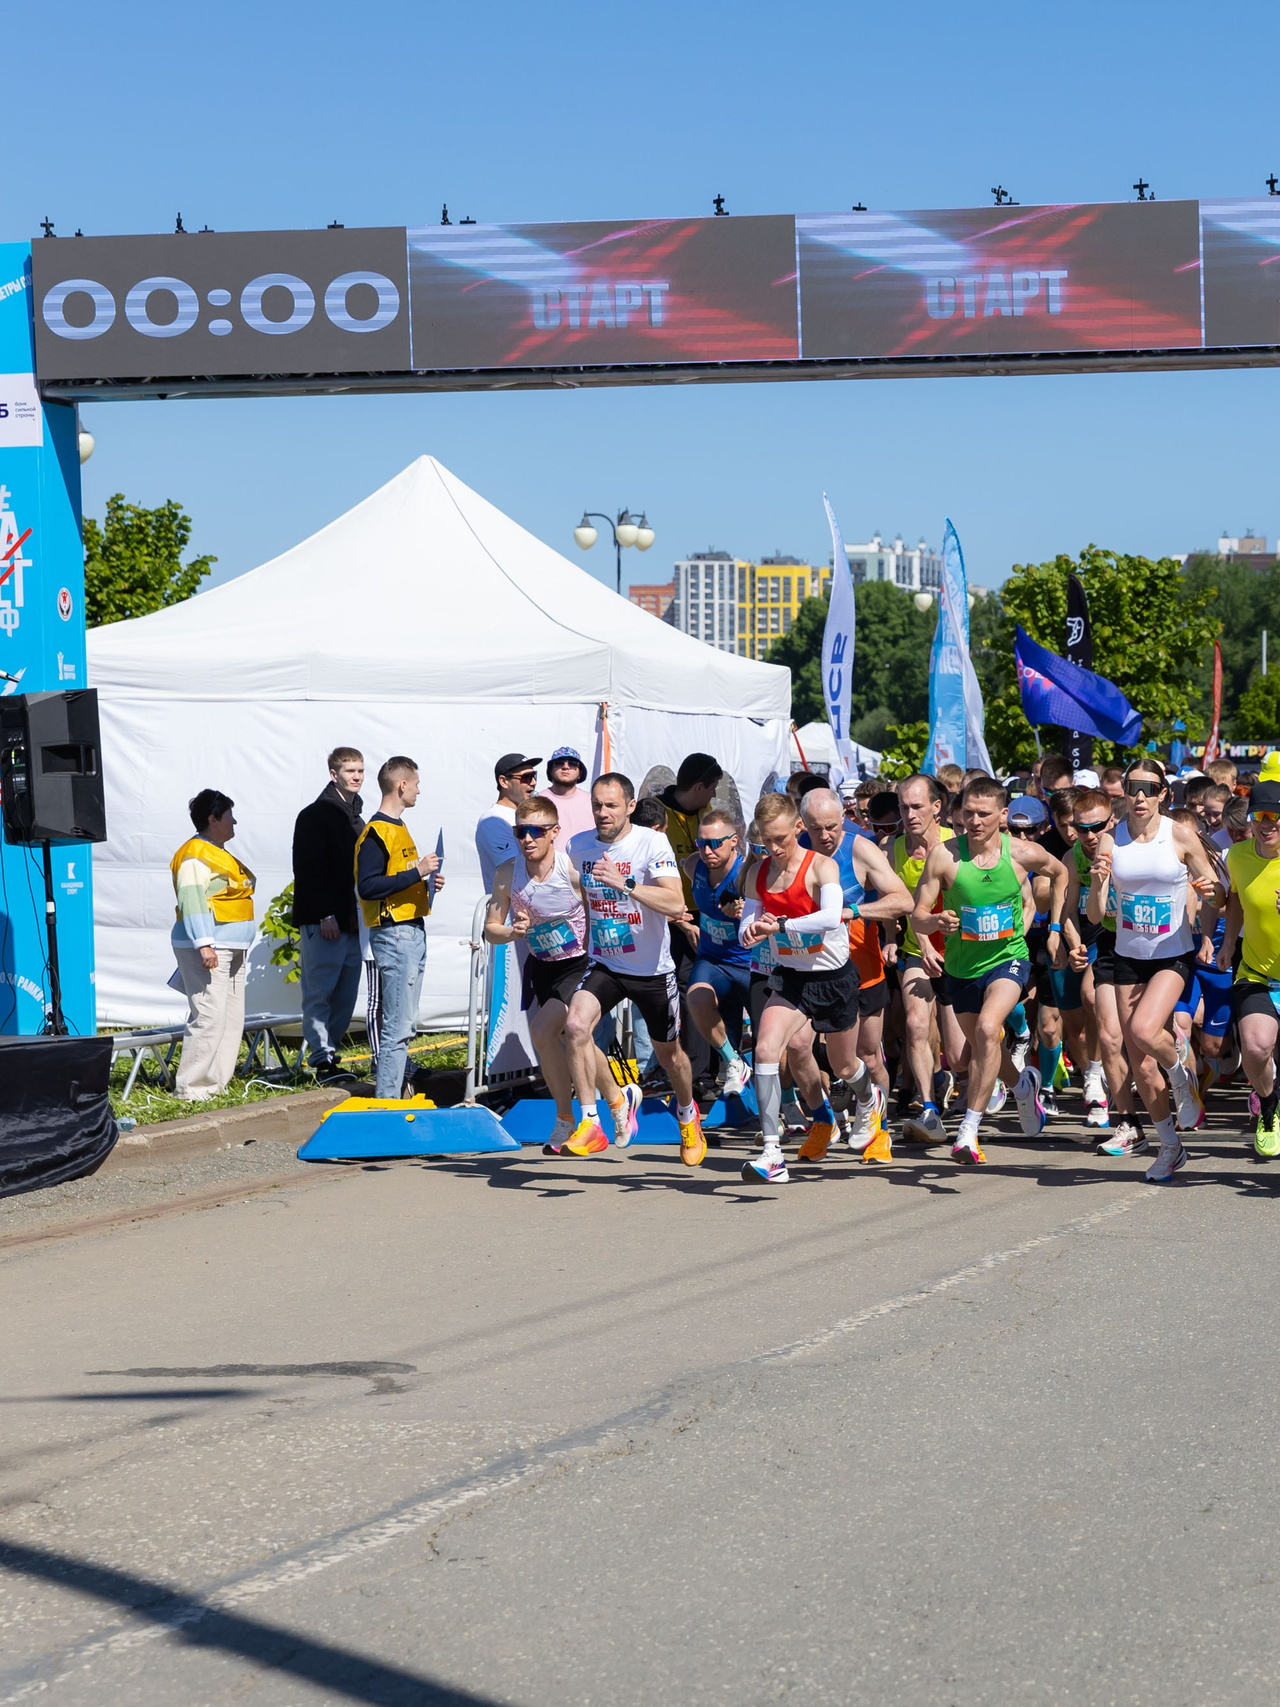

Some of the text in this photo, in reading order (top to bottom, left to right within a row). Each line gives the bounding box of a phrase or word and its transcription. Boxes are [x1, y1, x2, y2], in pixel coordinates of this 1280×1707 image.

[925, 268, 1068, 320] СТАРТ
[43, 270, 400, 341] 00:00
[531, 282, 670, 330] СТАРТ
[977, 913, 999, 933] 166
[1134, 904, 1156, 924] 921
[598, 928, 619, 947] 645
[1144, 925, 1149, 933] 5
[536, 929, 564, 950] 1330
